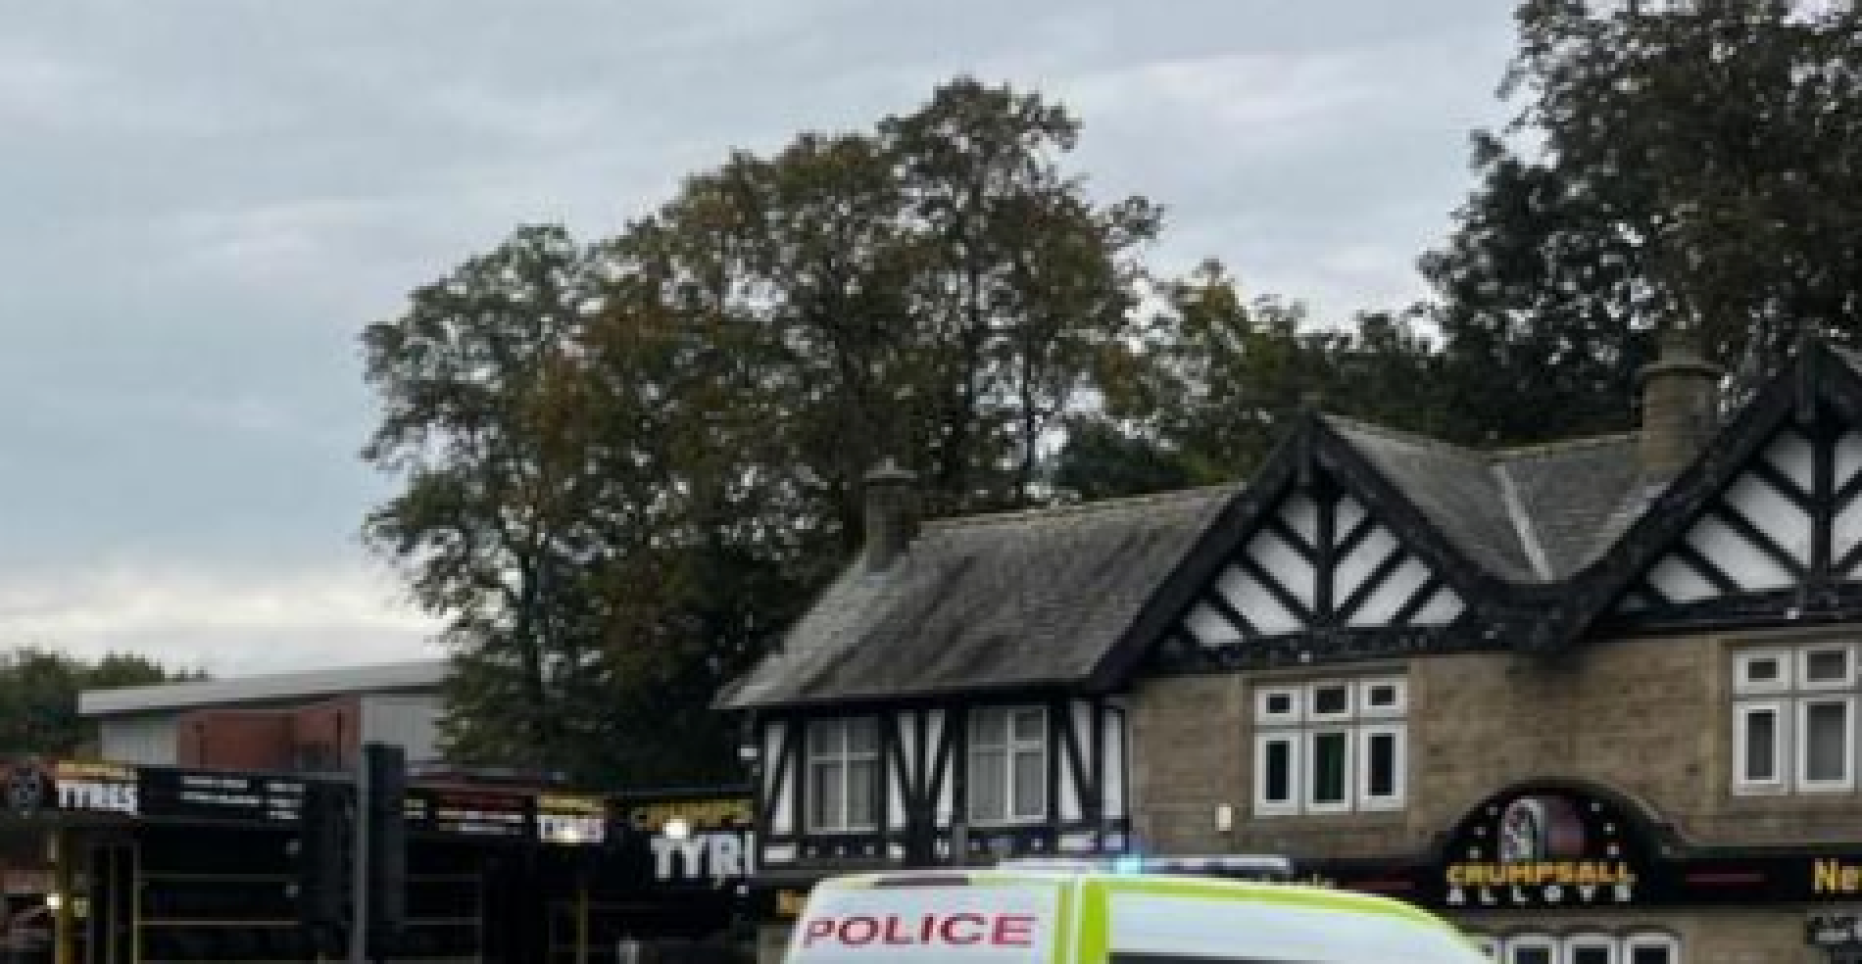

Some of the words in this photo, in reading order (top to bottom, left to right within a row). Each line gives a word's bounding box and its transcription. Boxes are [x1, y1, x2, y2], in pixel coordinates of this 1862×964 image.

[56, 780, 139, 816] TYRES
[1446, 861, 1635, 886] CRUMPSALL
[1813, 858, 1862, 893] Ne
[1446, 886, 1631, 905] ALLOYS
[802, 912, 1036, 948] POLICE
